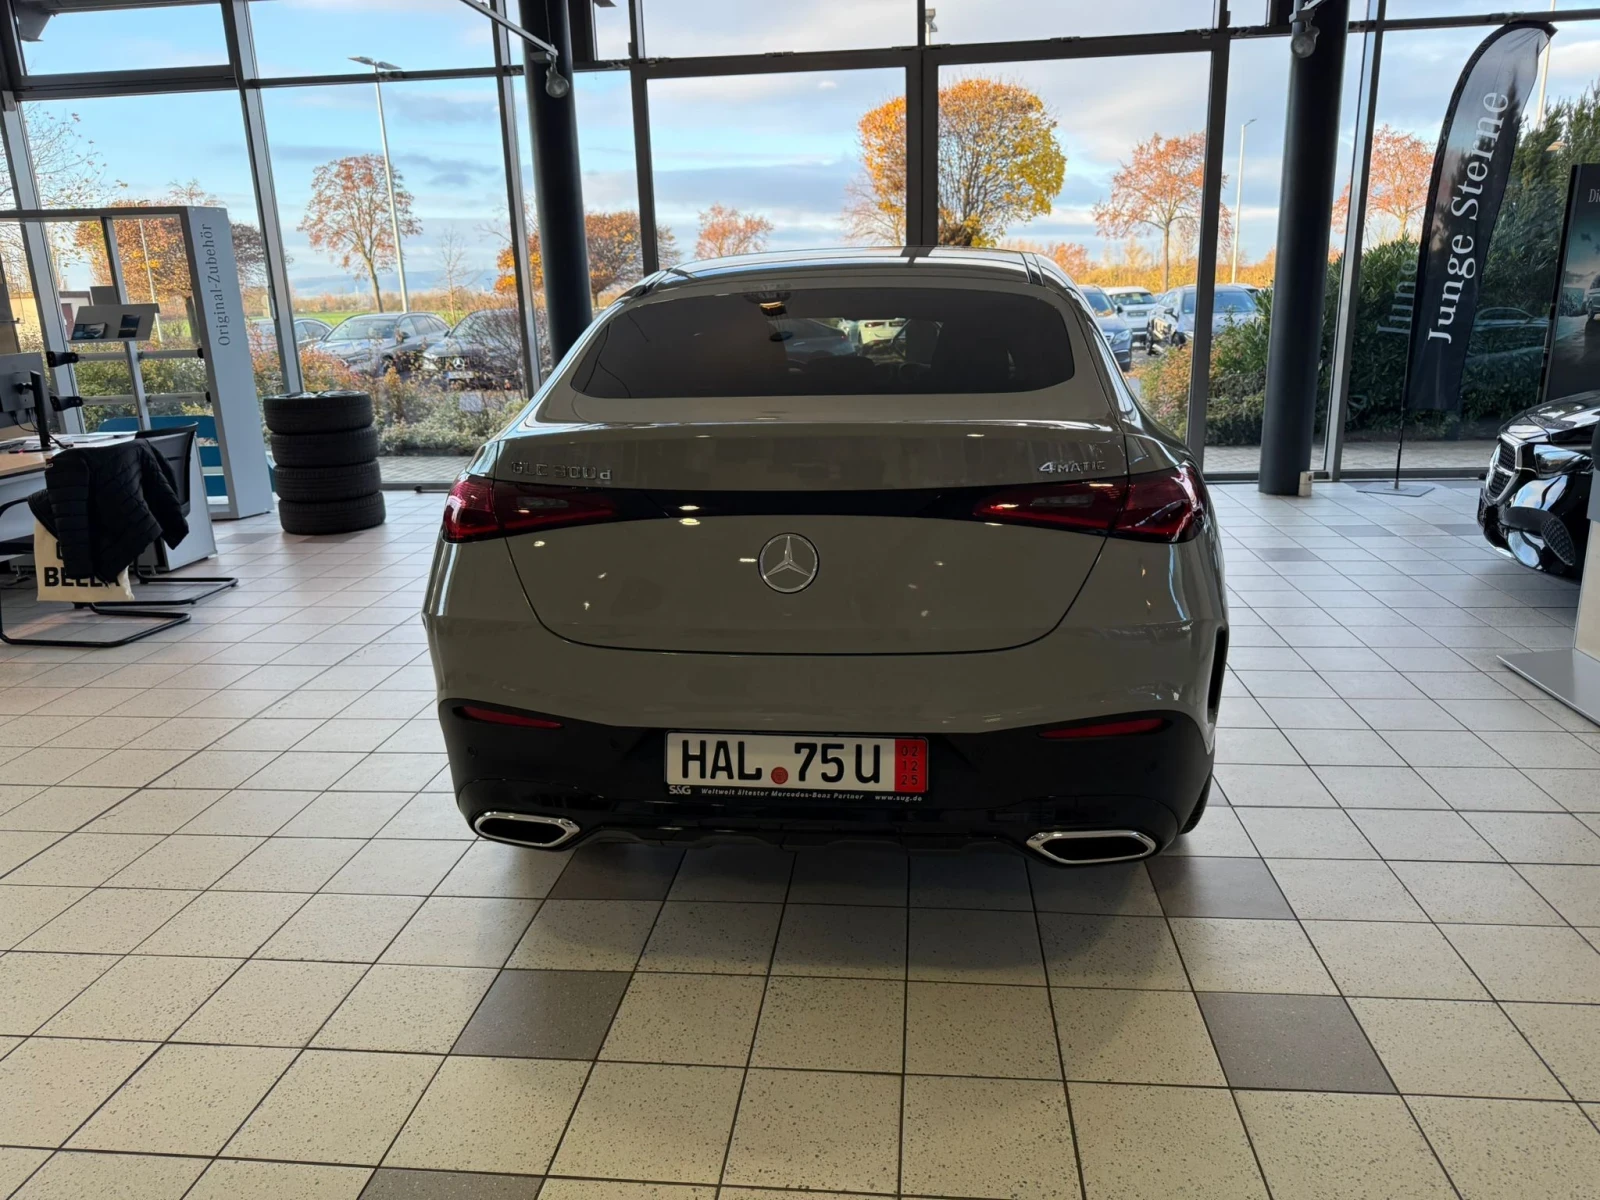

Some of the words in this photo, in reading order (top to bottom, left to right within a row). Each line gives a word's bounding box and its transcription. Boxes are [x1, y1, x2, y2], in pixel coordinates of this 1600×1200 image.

[1450, 91, 1509, 221] Sterne
[1588, 188, 1600, 203] Di
[200, 223, 231, 346] Original-Zubehör
[1427, 234, 1475, 344] Junge
[511, 461, 548, 477] GLC
[1038, 461, 1106, 474] 4MATIC
[900, 745, 919, 757] 02
[682, 739, 763, 780] HAL
[901, 760, 919, 771] 12
[900, 774, 919, 785] 25
[668, 785, 692, 795] S&G
[701, 787, 736, 796] Weltweit
[770, 790, 831, 799] Mercedes-Benz
[833, 792, 865, 800] Partner
[874, 794, 923, 803] www.sug.de
